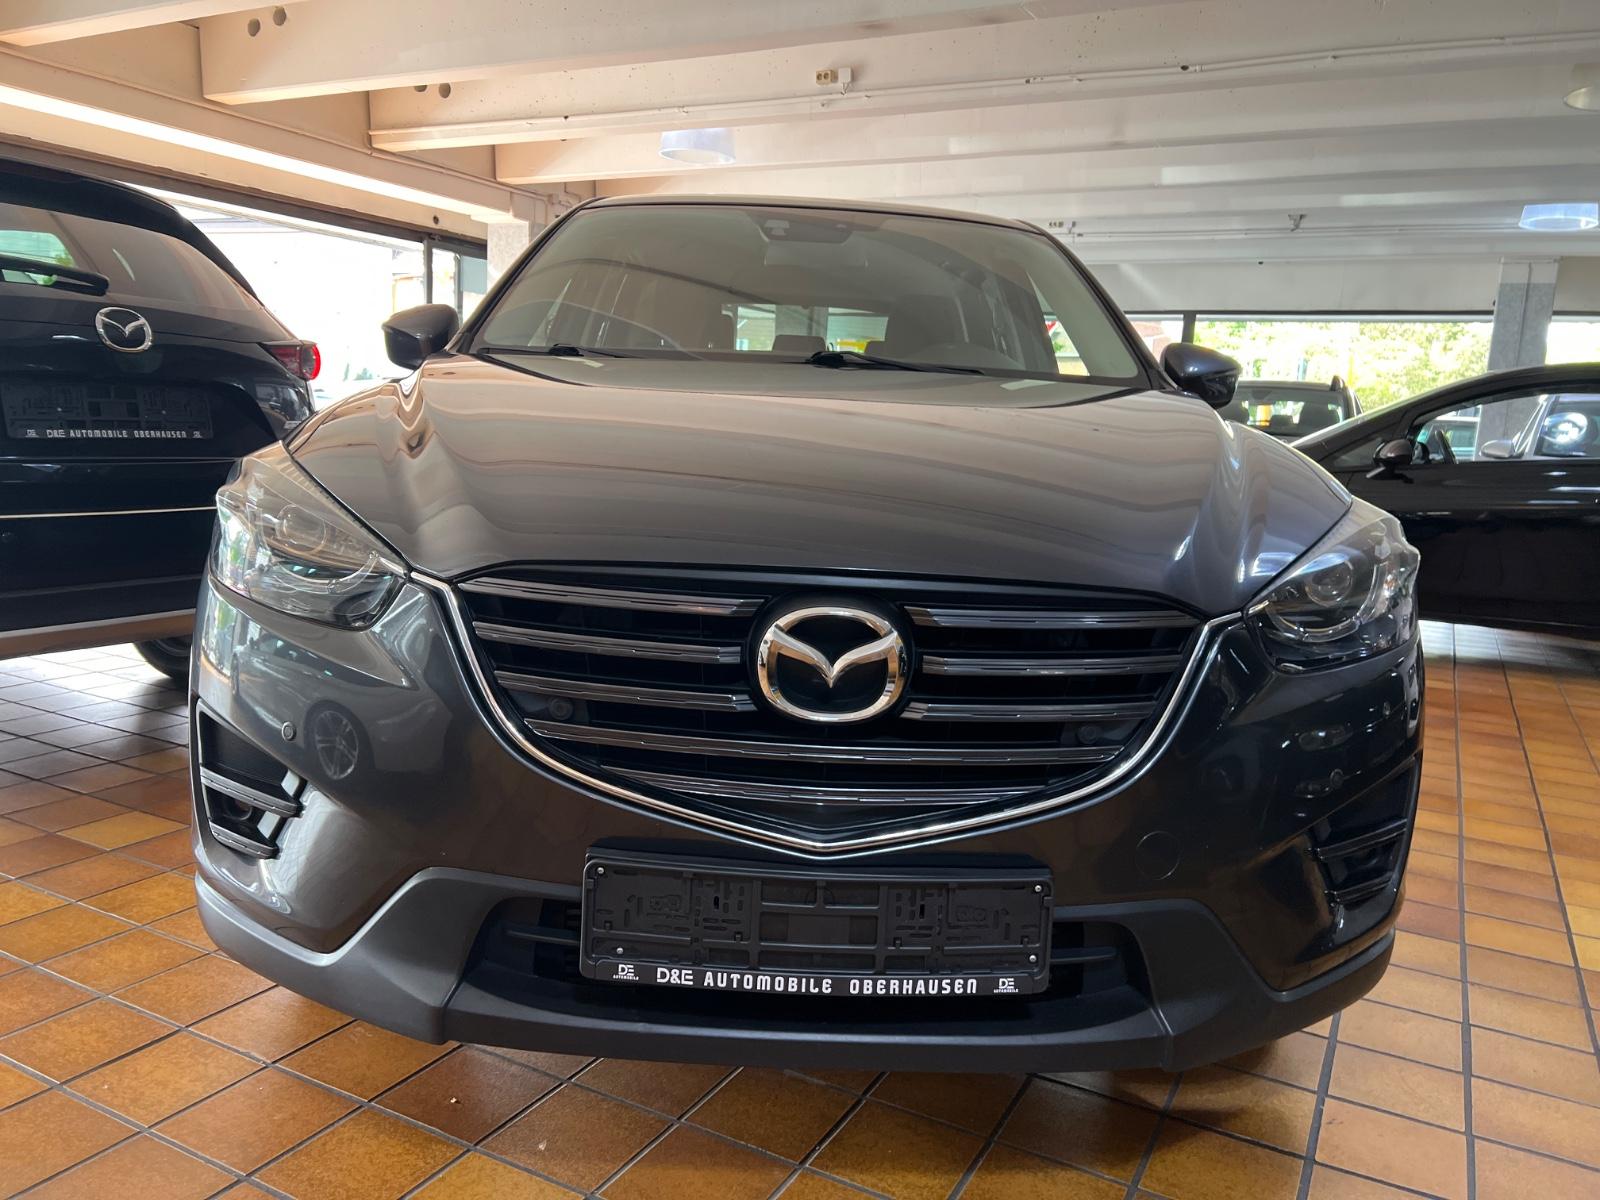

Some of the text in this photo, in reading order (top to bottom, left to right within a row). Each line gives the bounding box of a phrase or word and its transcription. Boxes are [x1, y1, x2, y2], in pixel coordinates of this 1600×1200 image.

[70, 430, 128, 438] AUTOMOBILE
[134, 430, 187, 438] OBERHAUSEN
[618, 964, 635, 976] DE
[656, 967, 977, 994] D&E AUTOMOBILE OBERHAUSEN
[999, 978, 1014, 989] DE
